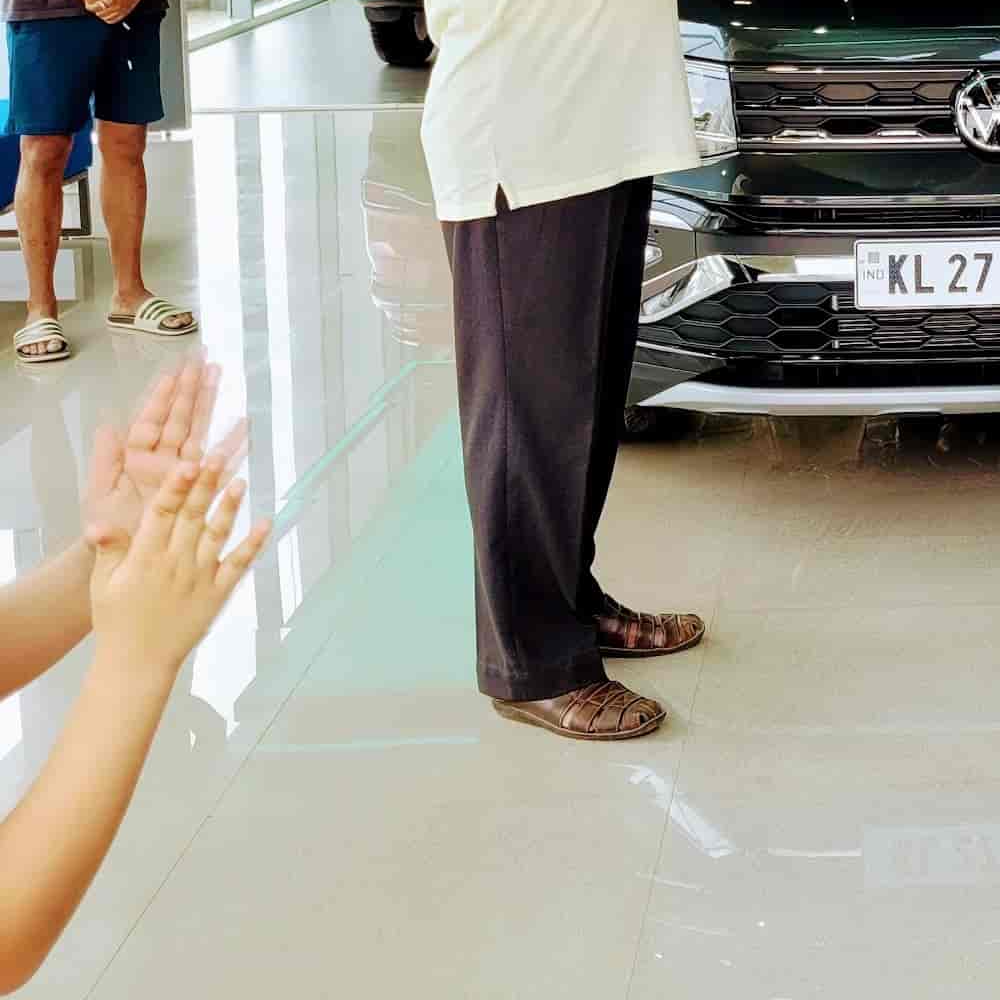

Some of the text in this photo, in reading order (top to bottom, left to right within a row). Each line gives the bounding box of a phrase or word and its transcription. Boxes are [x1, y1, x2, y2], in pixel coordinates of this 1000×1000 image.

[863, 269, 885, 281] IND
[888, 254, 934, 295] KL
[948, 252, 993, 294] 27
